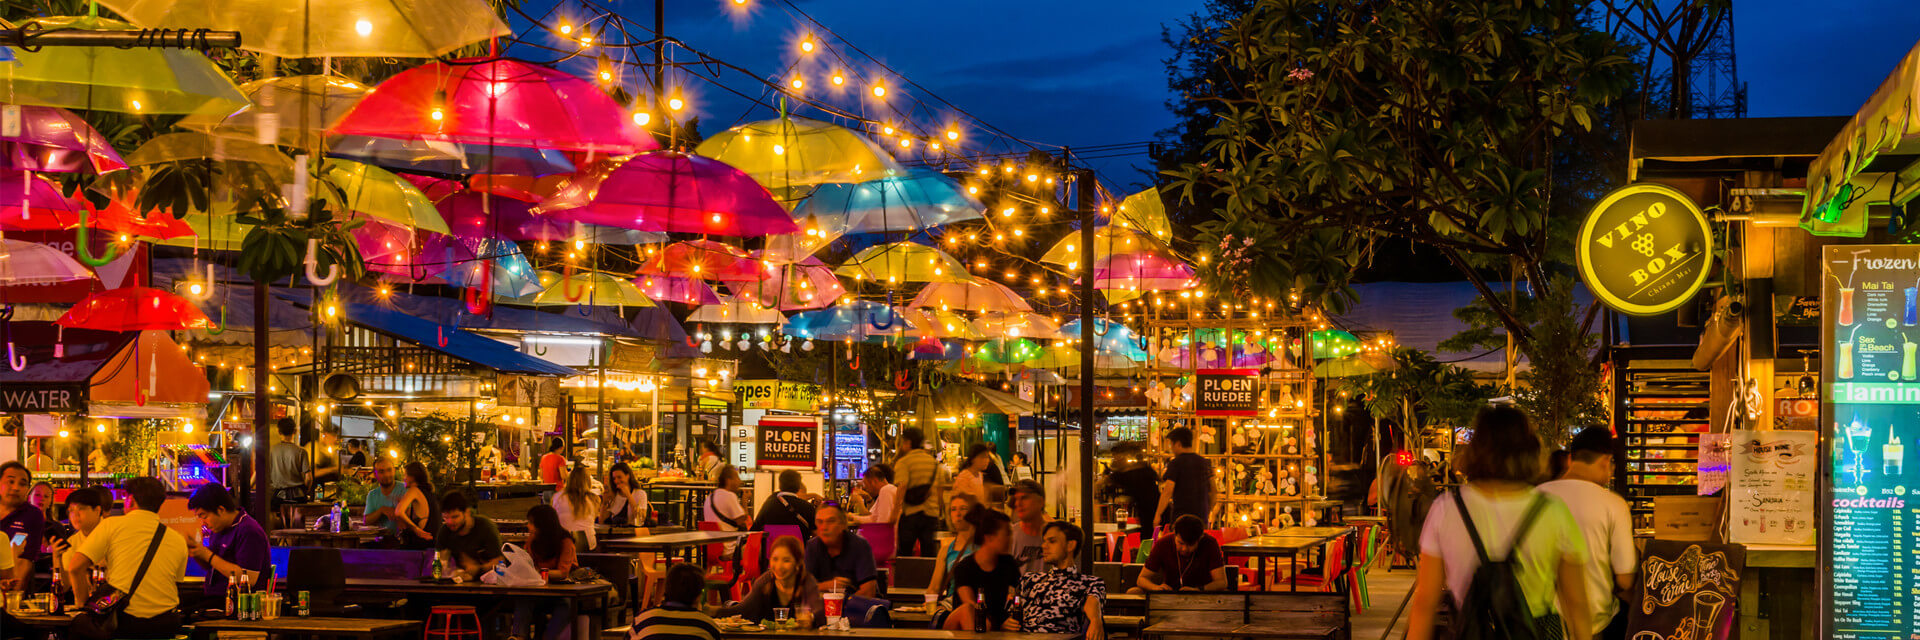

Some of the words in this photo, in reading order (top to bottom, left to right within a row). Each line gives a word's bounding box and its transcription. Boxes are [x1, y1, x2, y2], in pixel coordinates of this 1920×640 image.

[1596, 202, 1666, 248] VINO
[1629, 243, 1687, 287] BOX
[1851, 249, 1916, 270] Frozen
[1648, 278, 1676, 297] Chiang
[1676, 267, 1692, 280] Mai
[1862, 282, 1879, 290] Mai
[1882, 282, 1894, 290] Tai
[1204, 379, 1252, 391] PLOEN
[4, 391, 71, 409] WATER
[1204, 391, 1252, 402] RUEDEE
[765, 430, 811, 443] PLOEN
[739, 429, 747, 474] BEER
[765, 442, 811, 454] RUEDEE
[1832, 497, 1905, 508] cocktails
[1646, 561, 1680, 590] House
